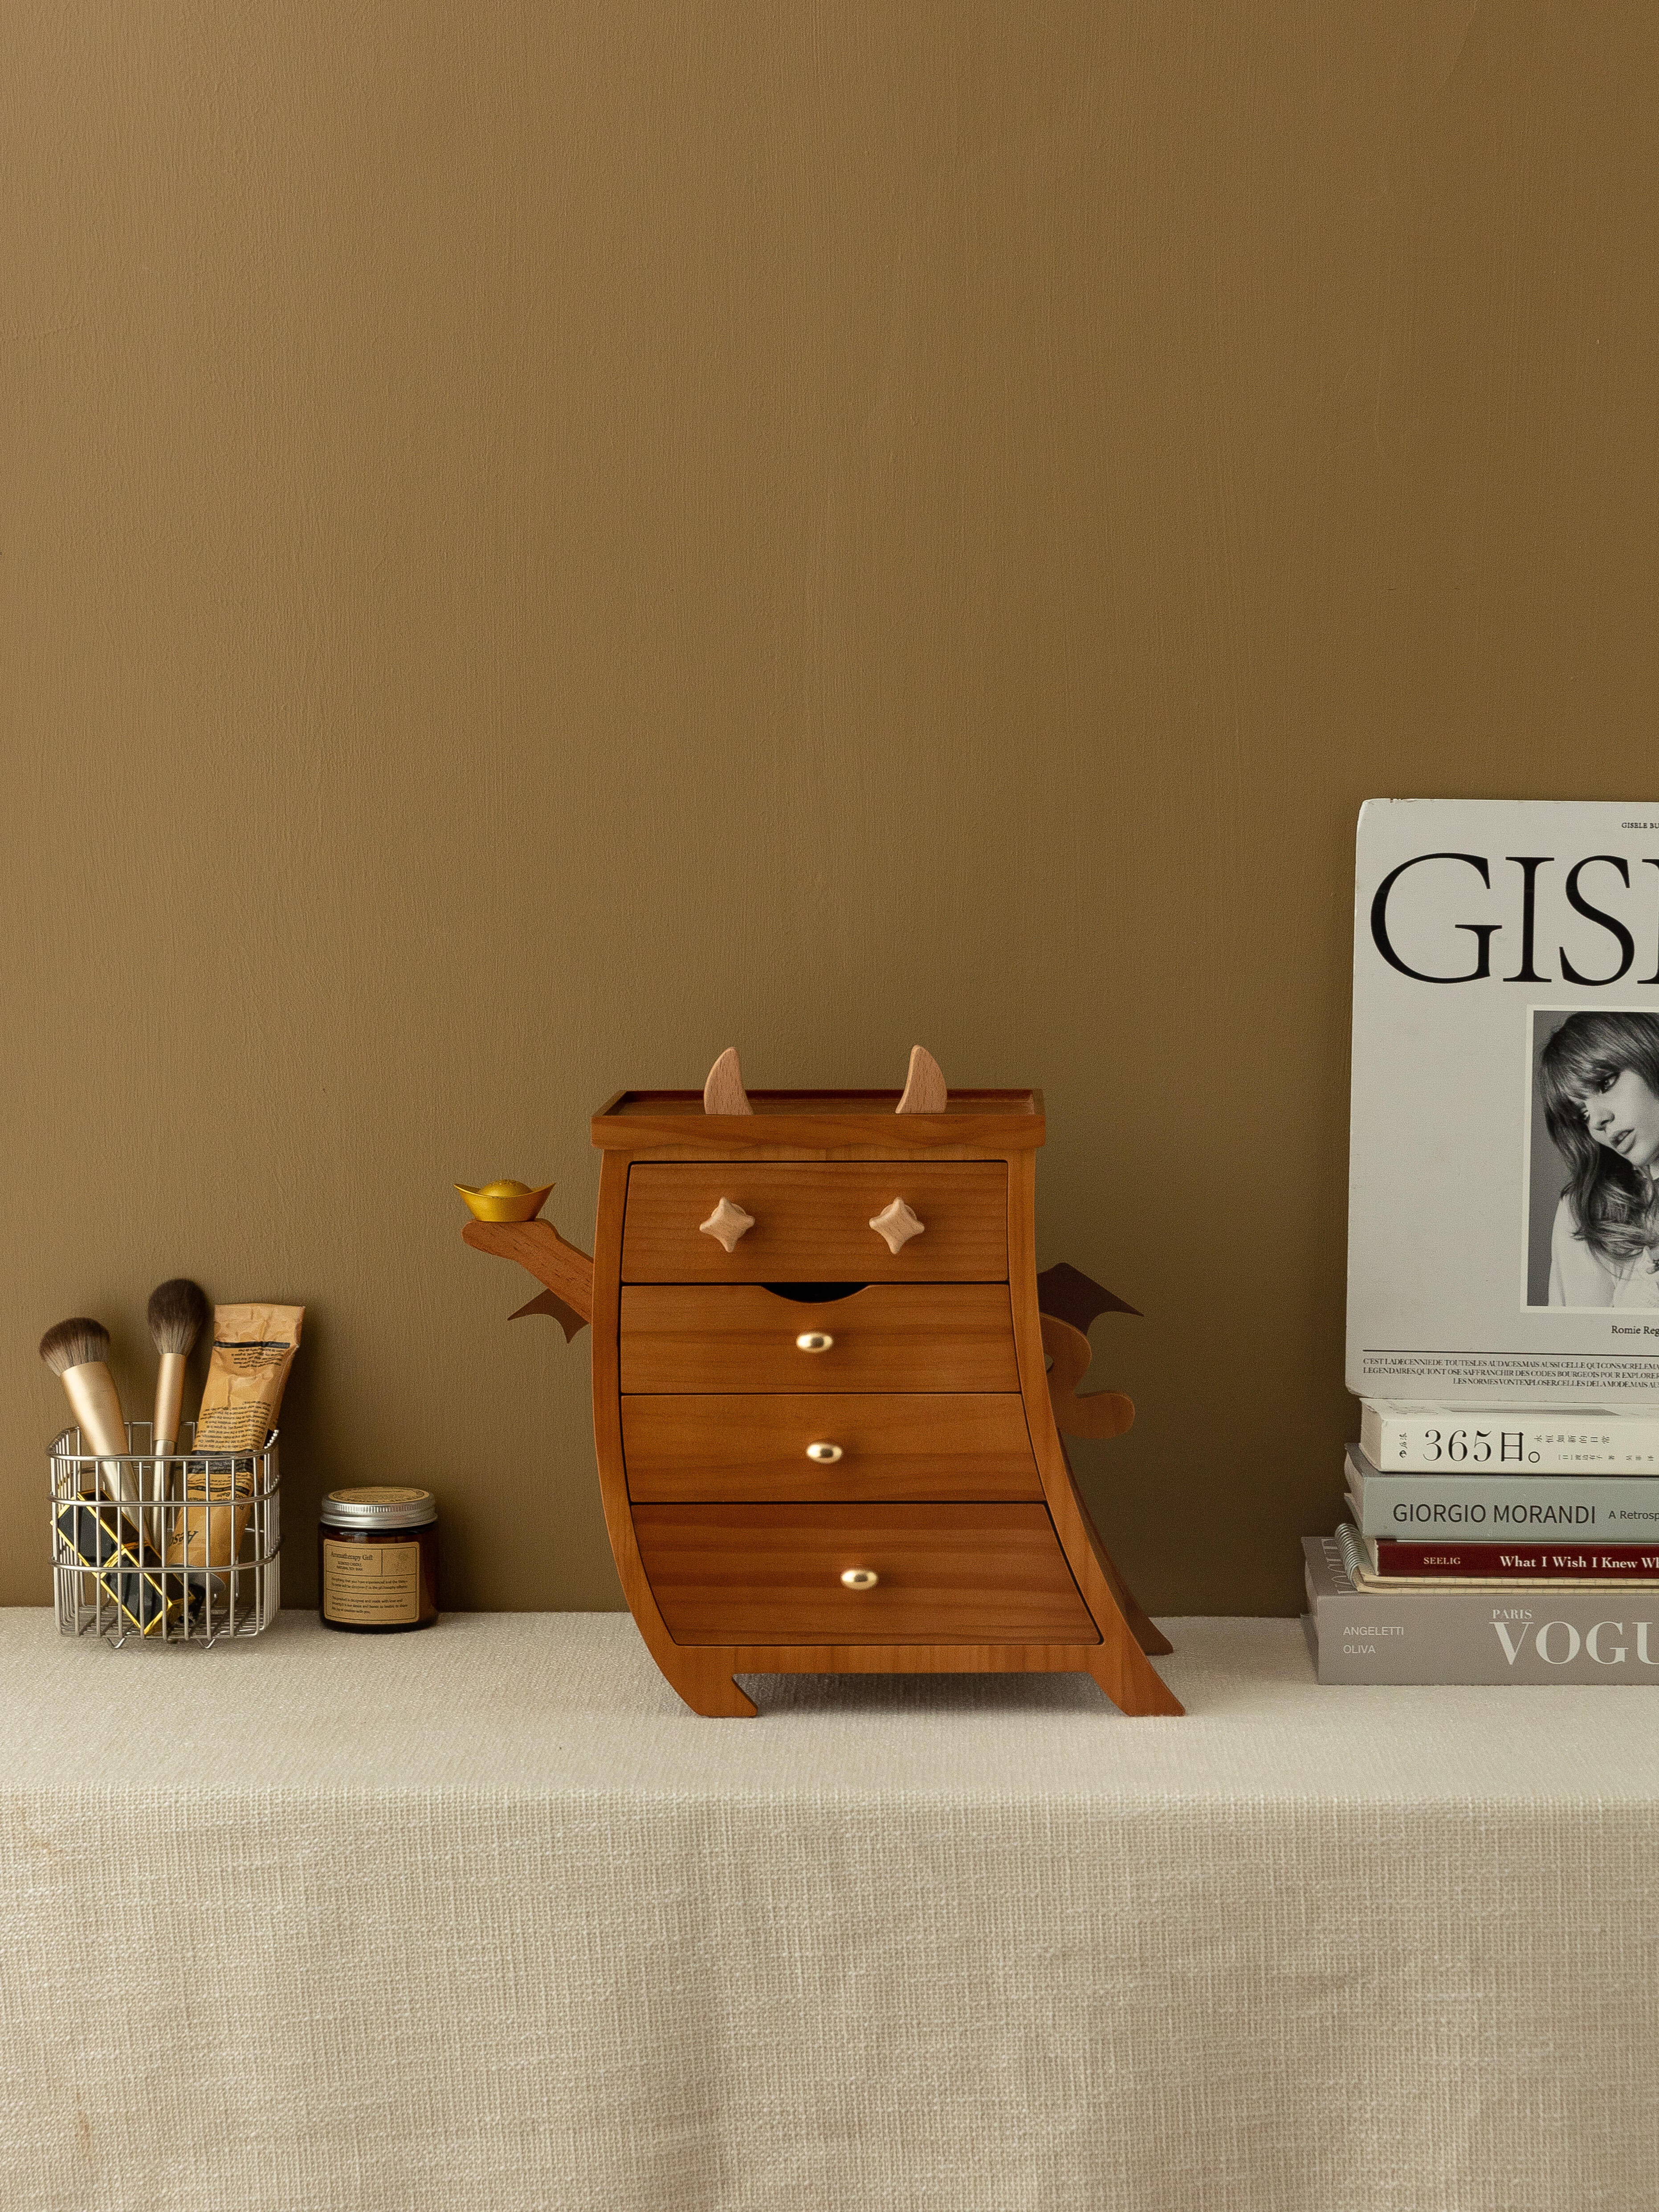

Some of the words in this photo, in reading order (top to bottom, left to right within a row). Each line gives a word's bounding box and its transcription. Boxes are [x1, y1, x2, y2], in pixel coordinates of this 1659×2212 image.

[1611, 1325, 1641, 1334] Romie
[1393, 1503, 1486, 1523] GIORGIO
[1494, 1504, 1596, 1524] MORANDI
[1608, 1511, 1616, 1519] A
[1620, 1510, 1659, 1521] Retrosp
[1423, 1556, 1461, 1565] SEELIG
[1500, 1555, 1536, 1567] What
[1542, 1556, 1547, 1567] I
[1553, 1556, 1587, 1568] Wish
[1592, 1557, 1598, 1568] I
[1602, 1557, 1638, 1568] Knew
[1492, 1609, 1532, 1619] PARIS
[1343, 1626, 1404, 1636] ANGELETTI
[1343, 1645, 1376, 1654] OLIVA
